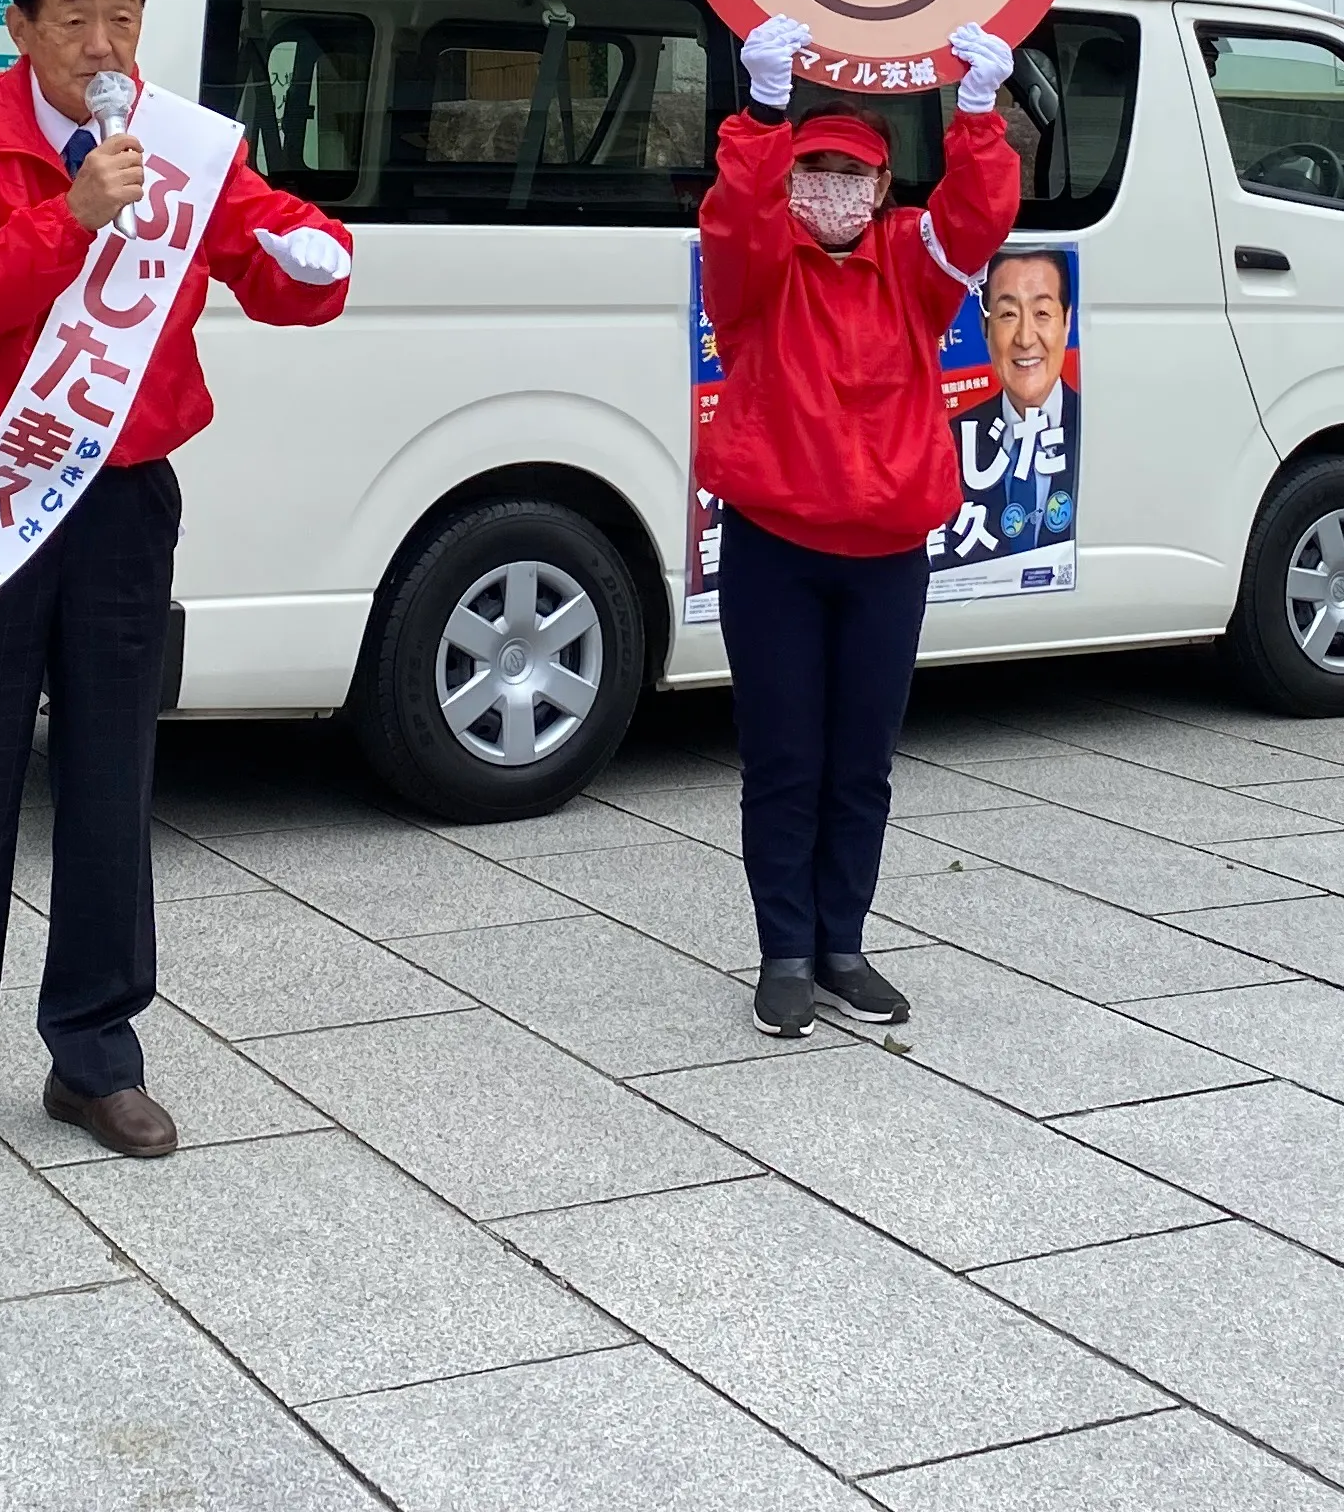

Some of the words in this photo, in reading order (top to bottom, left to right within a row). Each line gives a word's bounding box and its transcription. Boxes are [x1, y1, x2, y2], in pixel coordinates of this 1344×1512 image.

[18, 436, 102, 543] ゆきひさ
[960, 407, 1066, 491] じた
